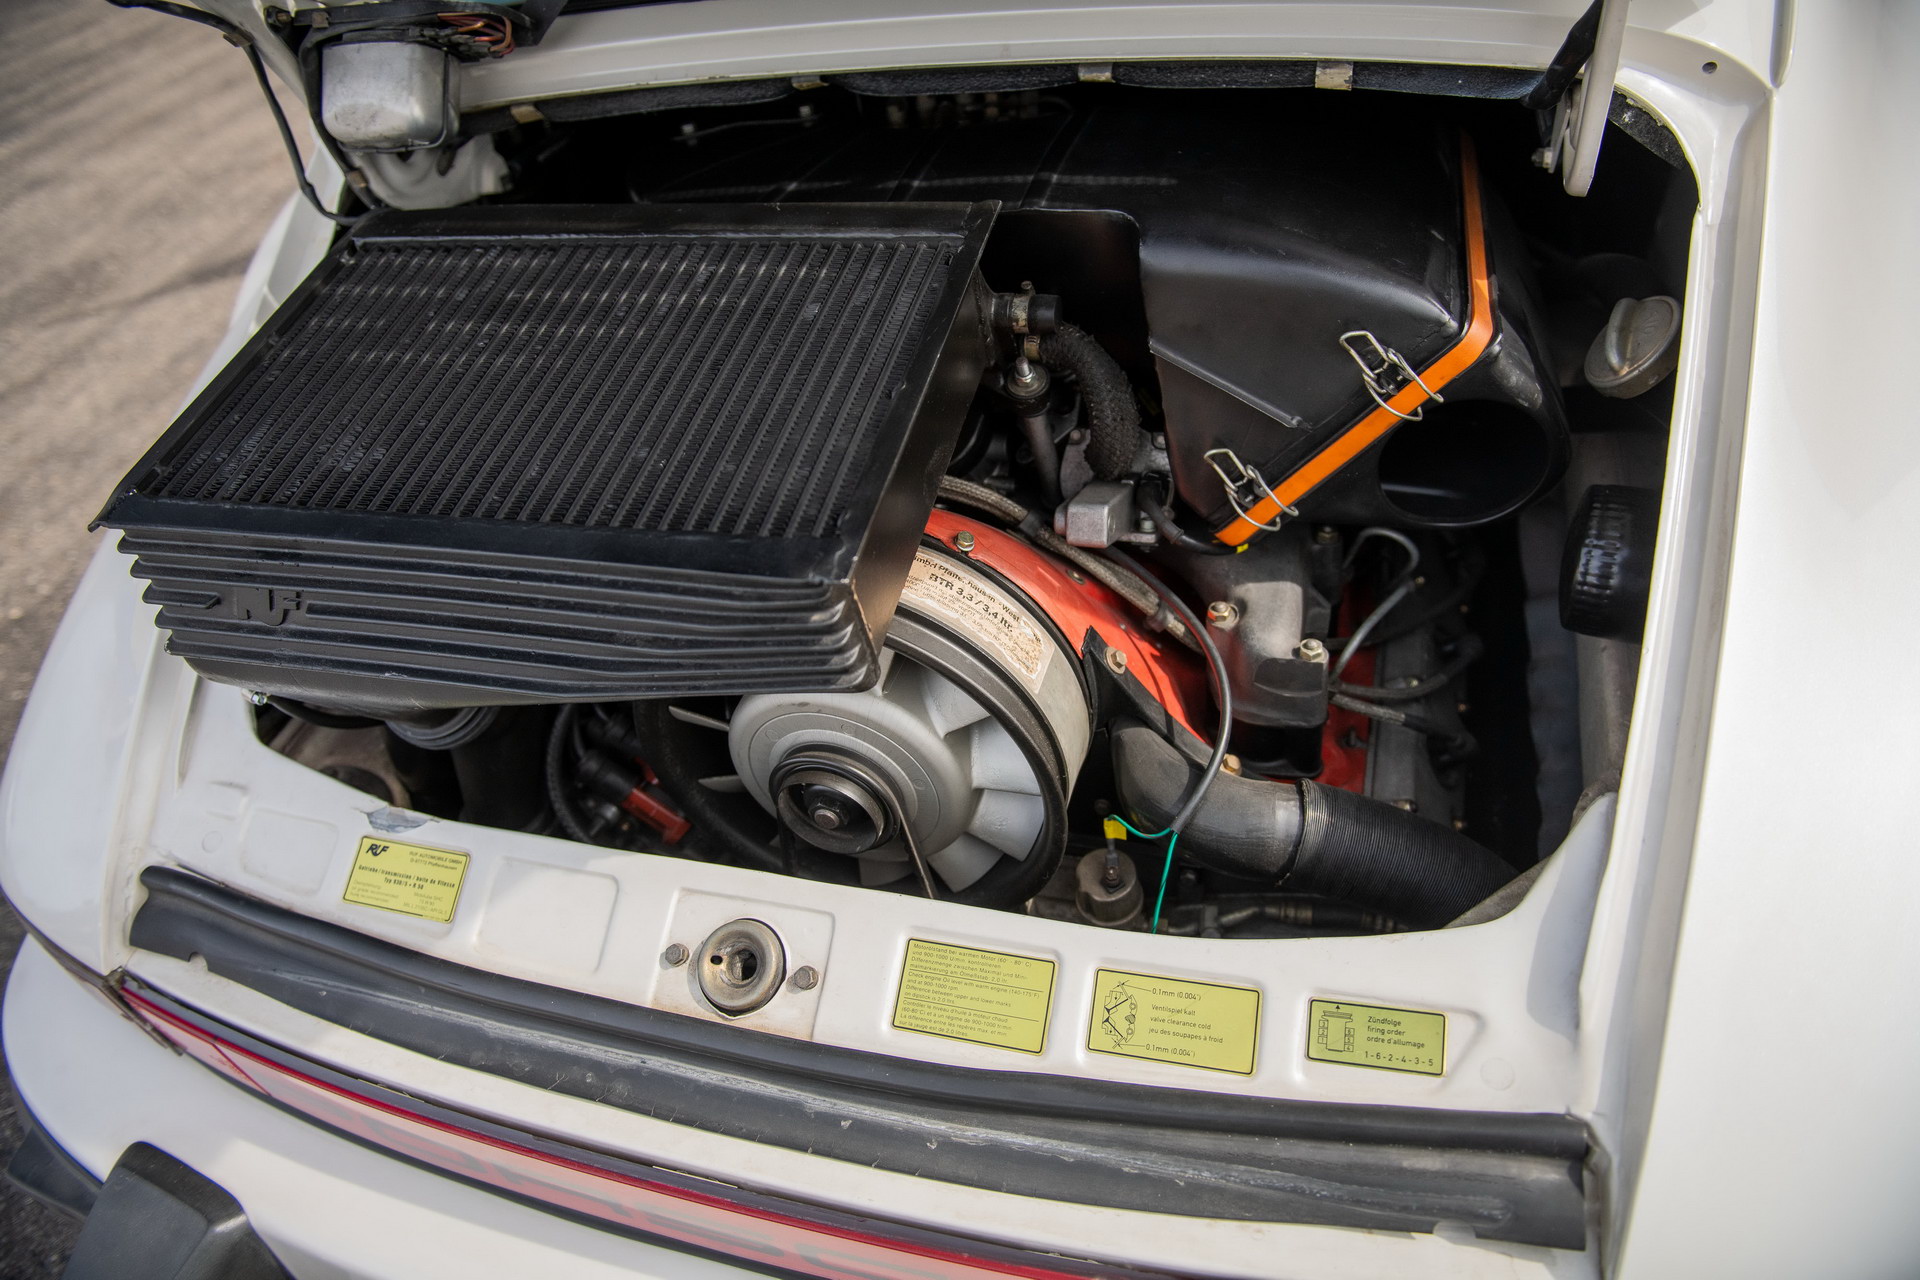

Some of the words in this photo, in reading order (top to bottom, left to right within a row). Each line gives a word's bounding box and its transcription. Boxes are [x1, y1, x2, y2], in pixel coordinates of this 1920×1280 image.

[955, 586, 974, 602] 3,3
[981, 603, 999, 619] 3,4
[366, 843, 389, 857] RUF
[925, 974, 942, 982] engine
[932, 989, 953, 997] between
[1151, 1005, 1184, 1015] Ventilspiel
[1150, 1016, 1166, 1024] valve
[1167, 1018, 1197, 1028] clearance
[1368, 1016, 1401, 1026] Zündfolge
[1161, 1029, 1171, 1037] des
[1172, 1031, 1202, 1041] soupapes
[1208, 1036, 1223, 1044] froid
[1367, 1026, 1385, 1035] firing
[1387, 1028, 1405, 1037] order
[1367, 1036, 1385, 1044] ordre
